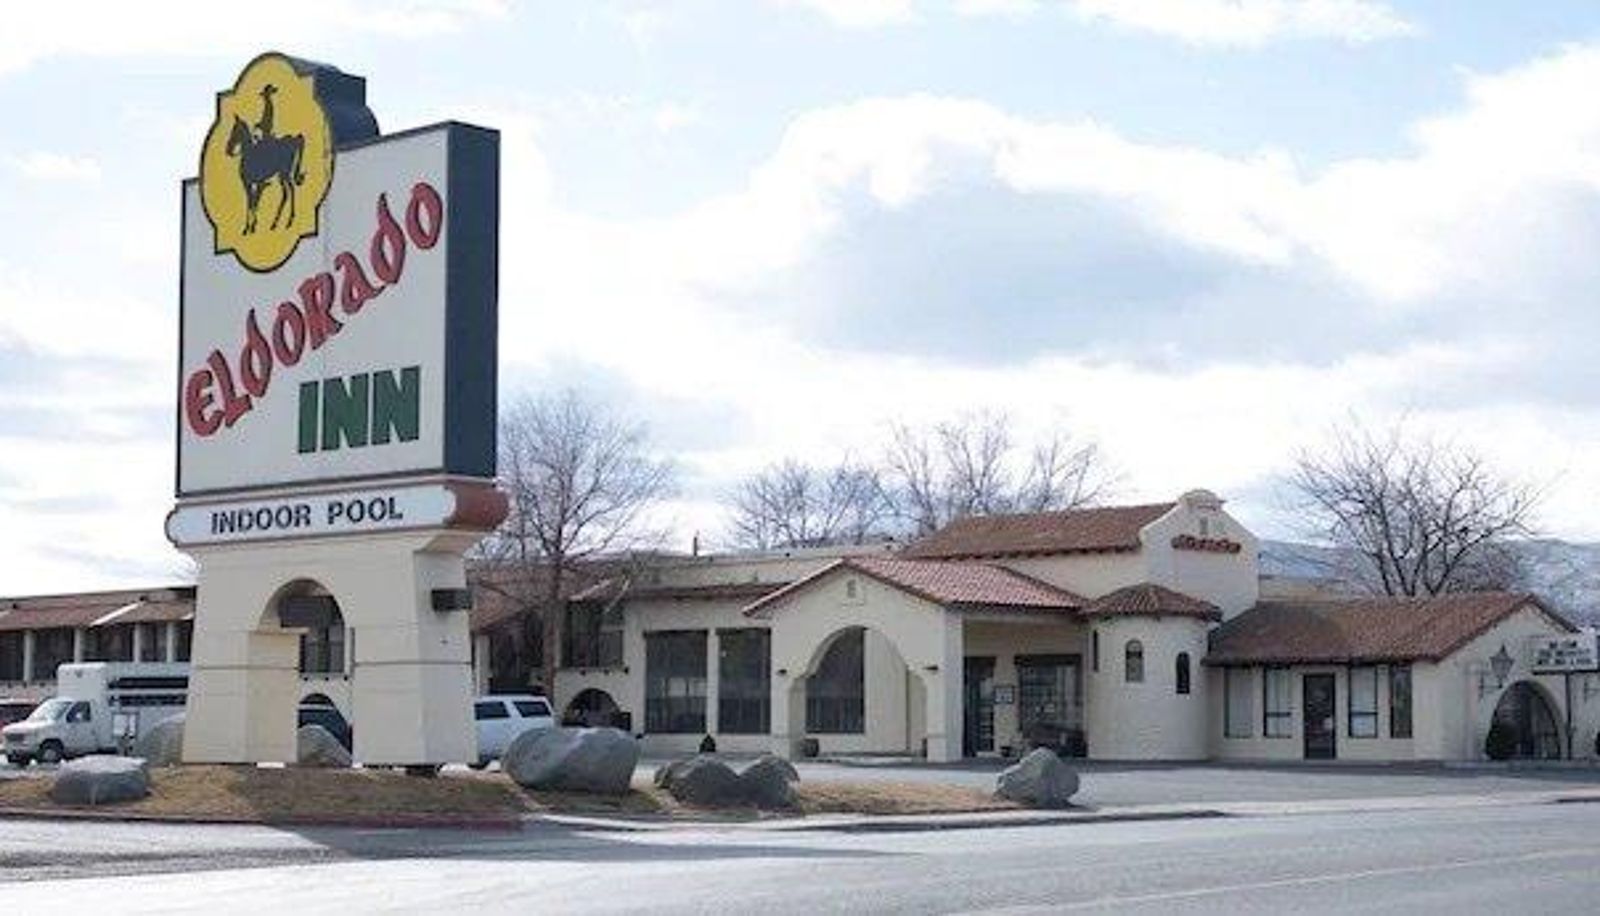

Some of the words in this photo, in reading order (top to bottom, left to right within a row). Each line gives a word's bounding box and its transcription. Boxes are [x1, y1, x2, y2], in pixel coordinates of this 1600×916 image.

[298, 365, 421, 453] INN
[211, 504, 311, 534] INDOOR
[328, 496, 403, 525] POOL
